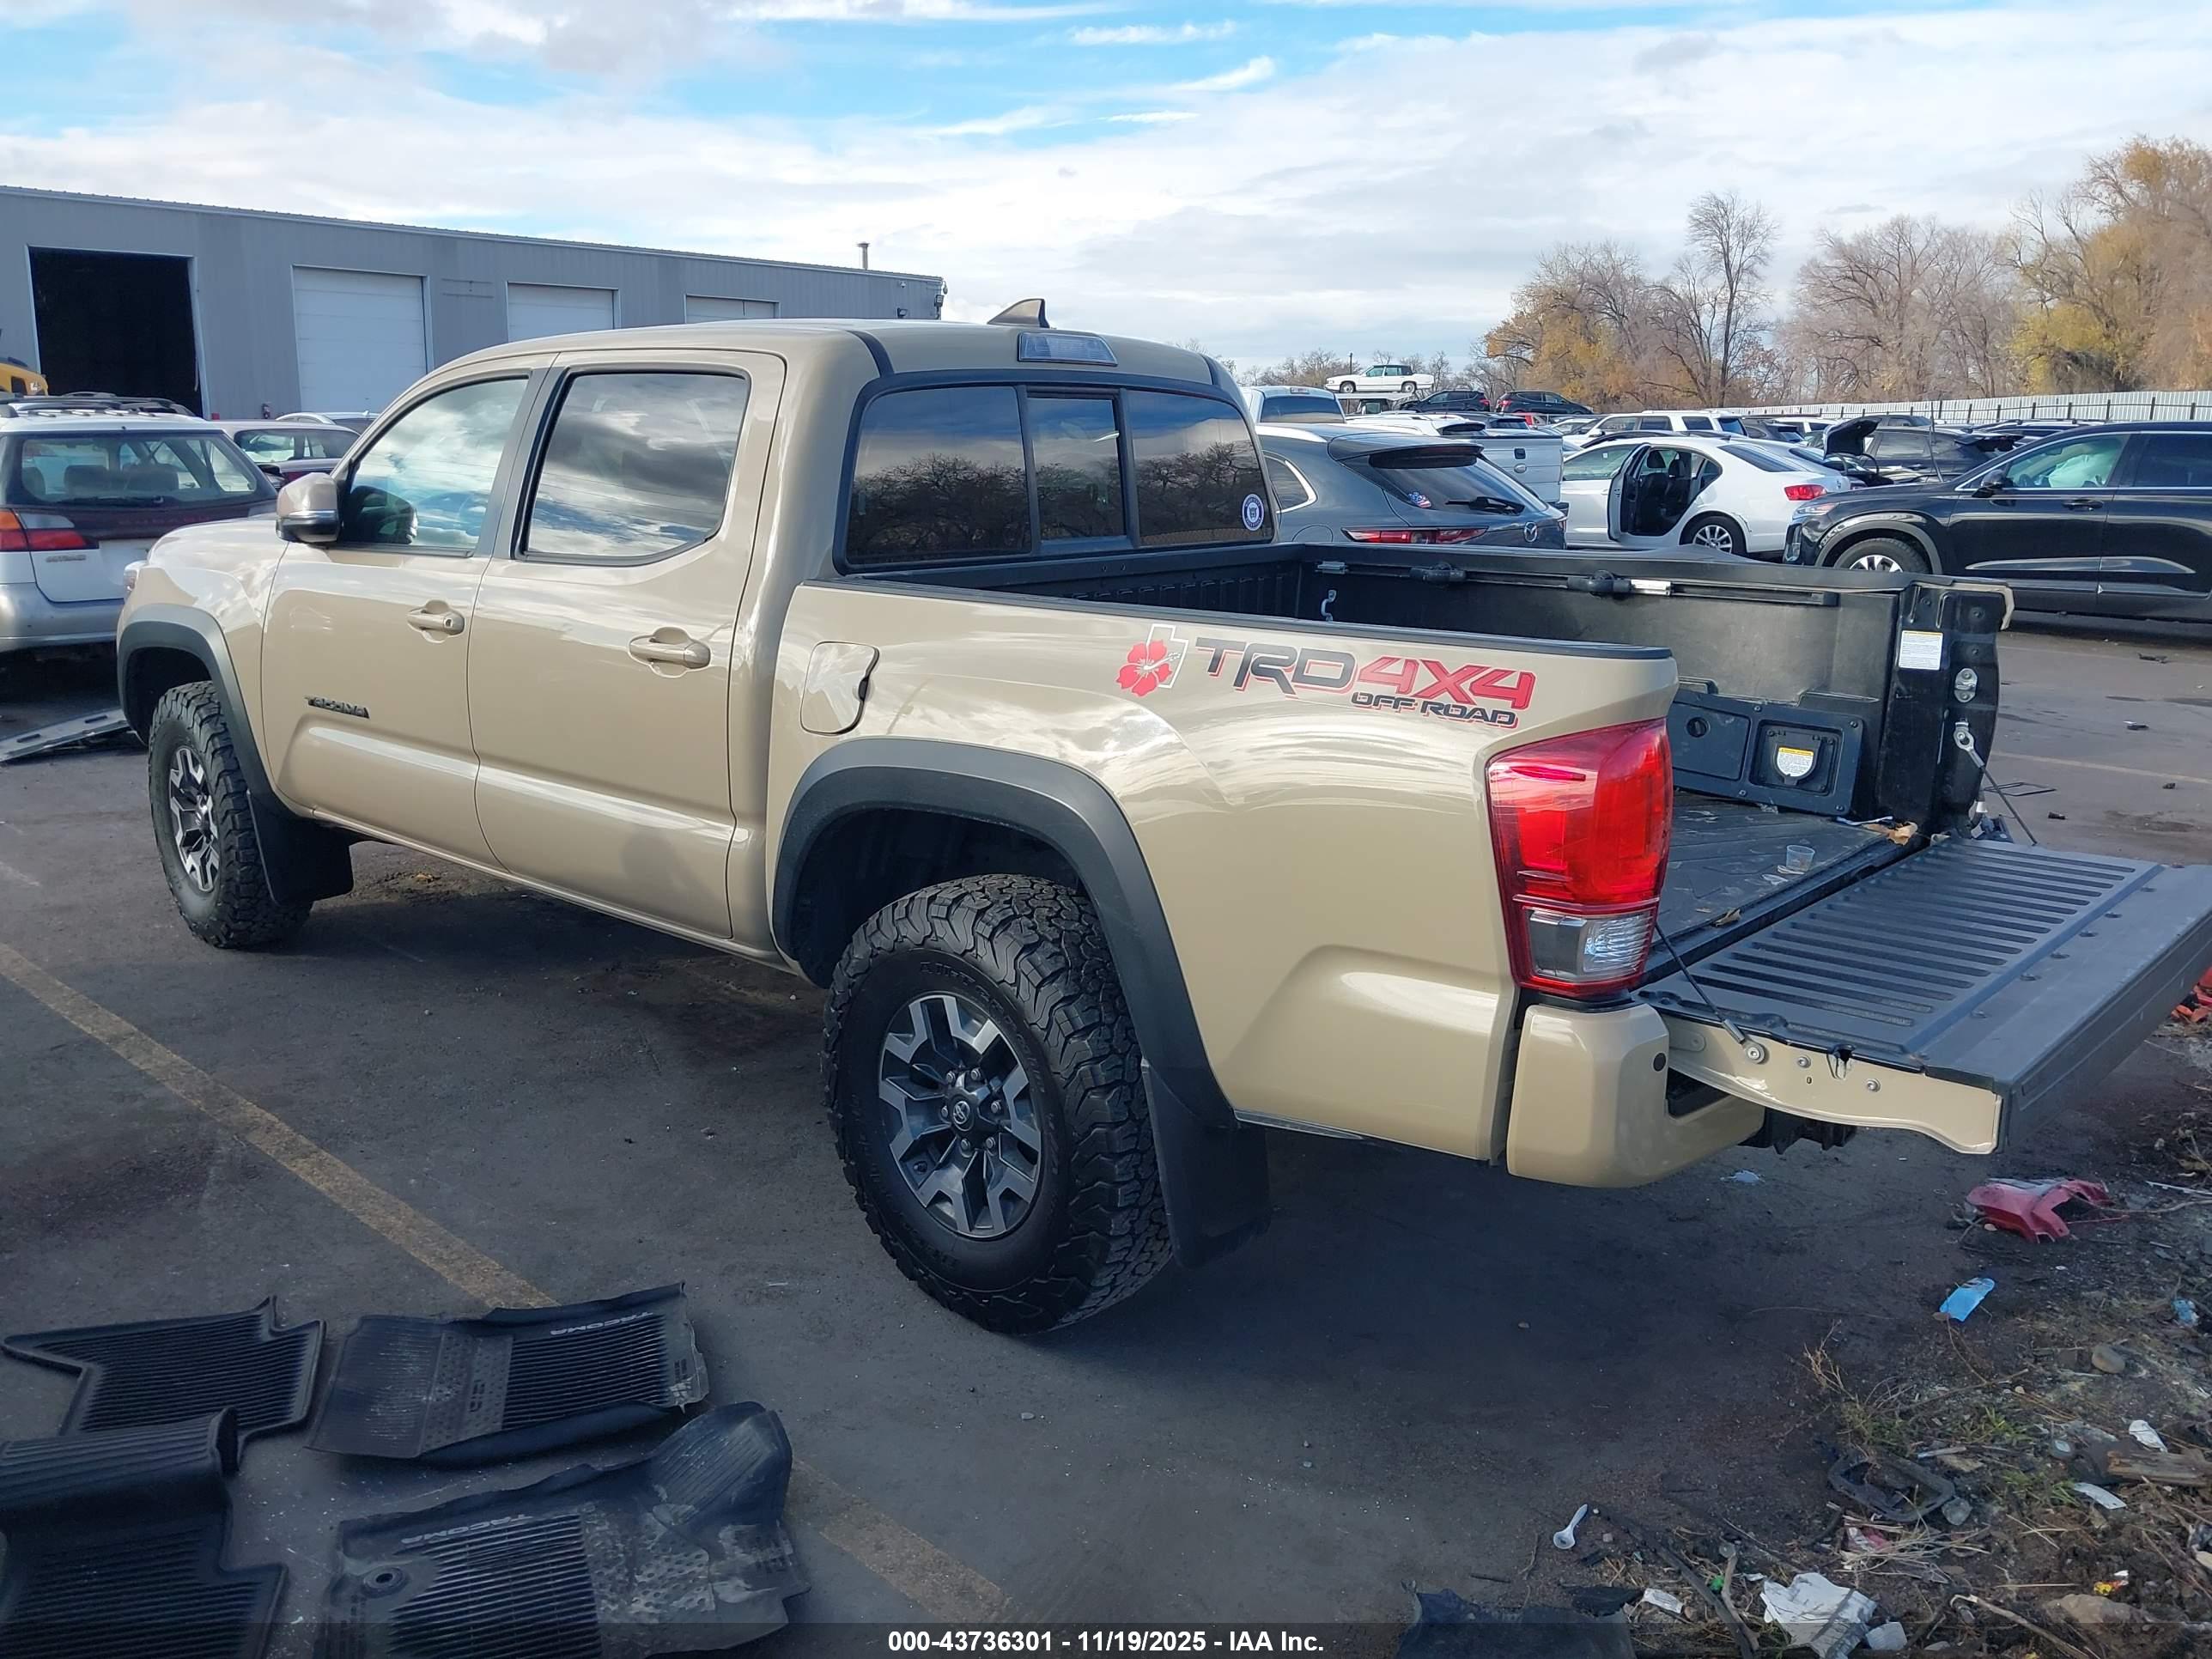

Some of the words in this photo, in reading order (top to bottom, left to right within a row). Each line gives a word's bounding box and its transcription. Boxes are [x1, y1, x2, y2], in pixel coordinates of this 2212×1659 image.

[1351, 690, 1419, 712] OFF
[1420, 700, 1519, 729] ROAD
[550, 1311, 653, 1335] TACOMA
[401, 1514, 534, 1544] TACOMA
